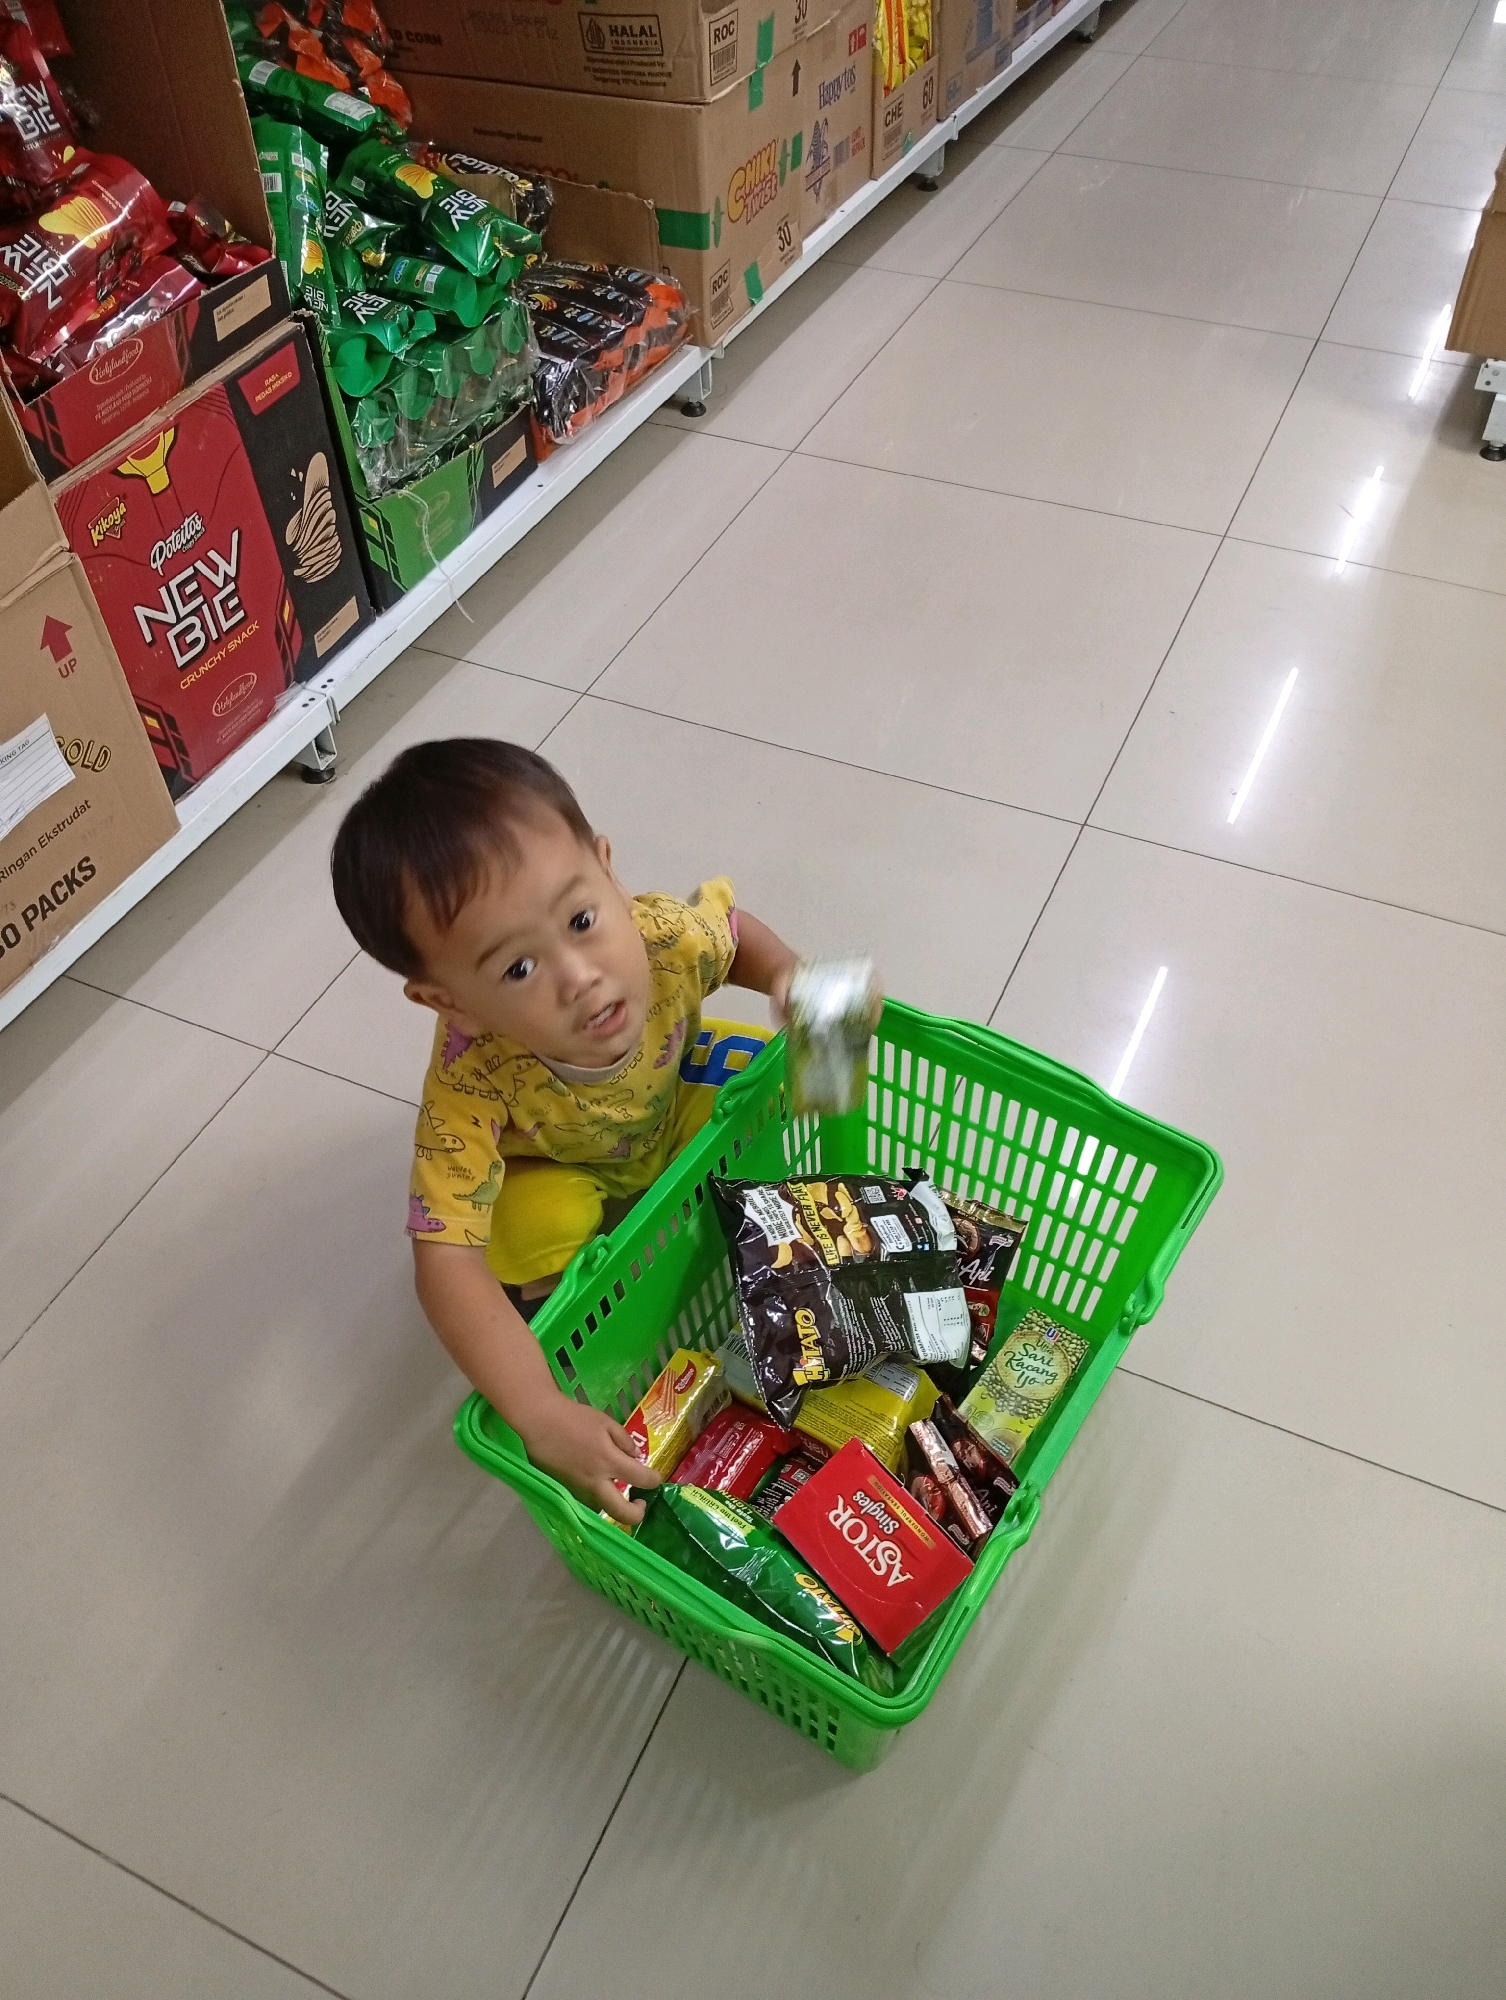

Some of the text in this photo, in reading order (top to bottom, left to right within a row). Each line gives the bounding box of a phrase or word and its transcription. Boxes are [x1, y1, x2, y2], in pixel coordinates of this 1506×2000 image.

[406, 31, 443, 45] CORN
[609, 24, 657, 38] HALAL
[714, 20, 734, 45] ROC
[819, 66, 856, 110] Happytos
[923, 76, 934, 109] 60
[884, 100, 903, 127] CHE
[448, 153, 521, 183] POTATO
[776, 221, 792, 252] 30
[712, 273, 730, 295] ROC
[90, 502, 126, 546] Kikoya
[151, 511, 203, 576] Poteitos
[133, 529, 240, 644] NEW
[166, 581, 246, 668] BIE
[58, 657, 78, 680] UP
[180, 620, 260, 690] CRUNCHY SNACK
[18, 739, 31, 752] TAG
[37, 799, 92, 849] Ekstrudat
[21, 855, 97, 932] PACKS
[773, 1220, 788, 1240] MORE
[790, 1184, 838, 1262] LIFE IS NEVER FLAT
[958, 1259, 995, 1286] Api
[1003, 1350, 1059, 1385] Kacang
[1017, 1342, 1055, 1367] Sari
[724, 1499, 754, 1523] Taste the
[731, 1515, 747, 1530] Feel
[852, 1490, 900, 1535] Singles
[872, 1479, 930, 1542] WONDERFUL SENSATION
[828, 1494, 915, 1587] ASTOR
